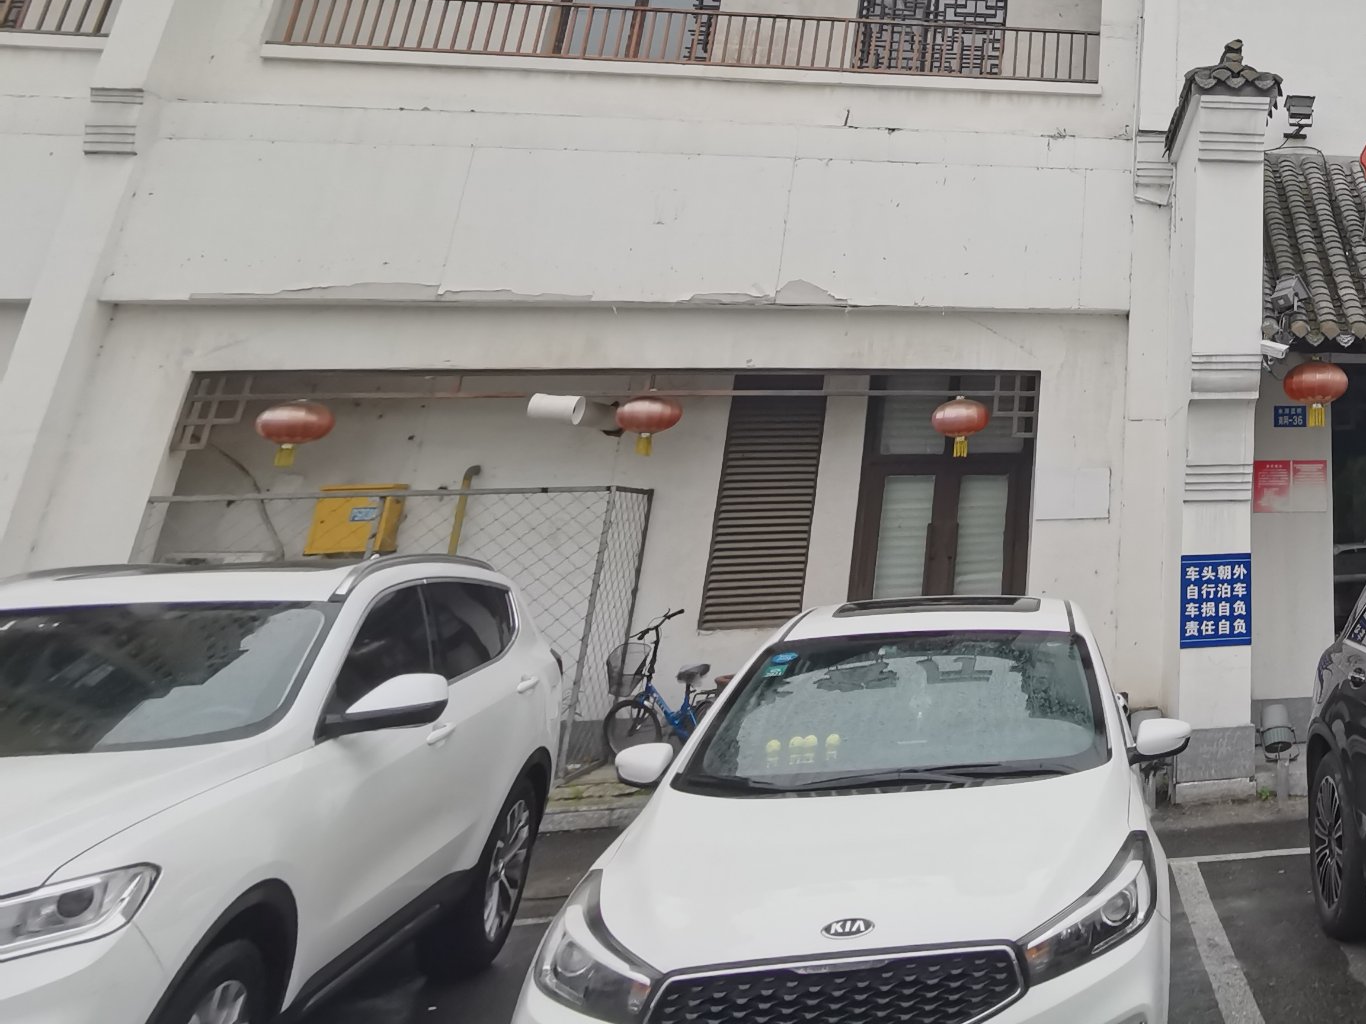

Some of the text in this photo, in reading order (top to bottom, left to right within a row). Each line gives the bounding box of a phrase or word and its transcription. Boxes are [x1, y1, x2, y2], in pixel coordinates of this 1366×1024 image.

[1278, 415, 1303, 426] -36
[1185, 563, 1247, 581] 车头朝外
[1186, 582, 1247, 600] 自行泊车
[1185, 600, 1247, 618] 车损自负
[1185, 618, 1247, 636] 责任自负
[829, 919, 866, 934] KIA
